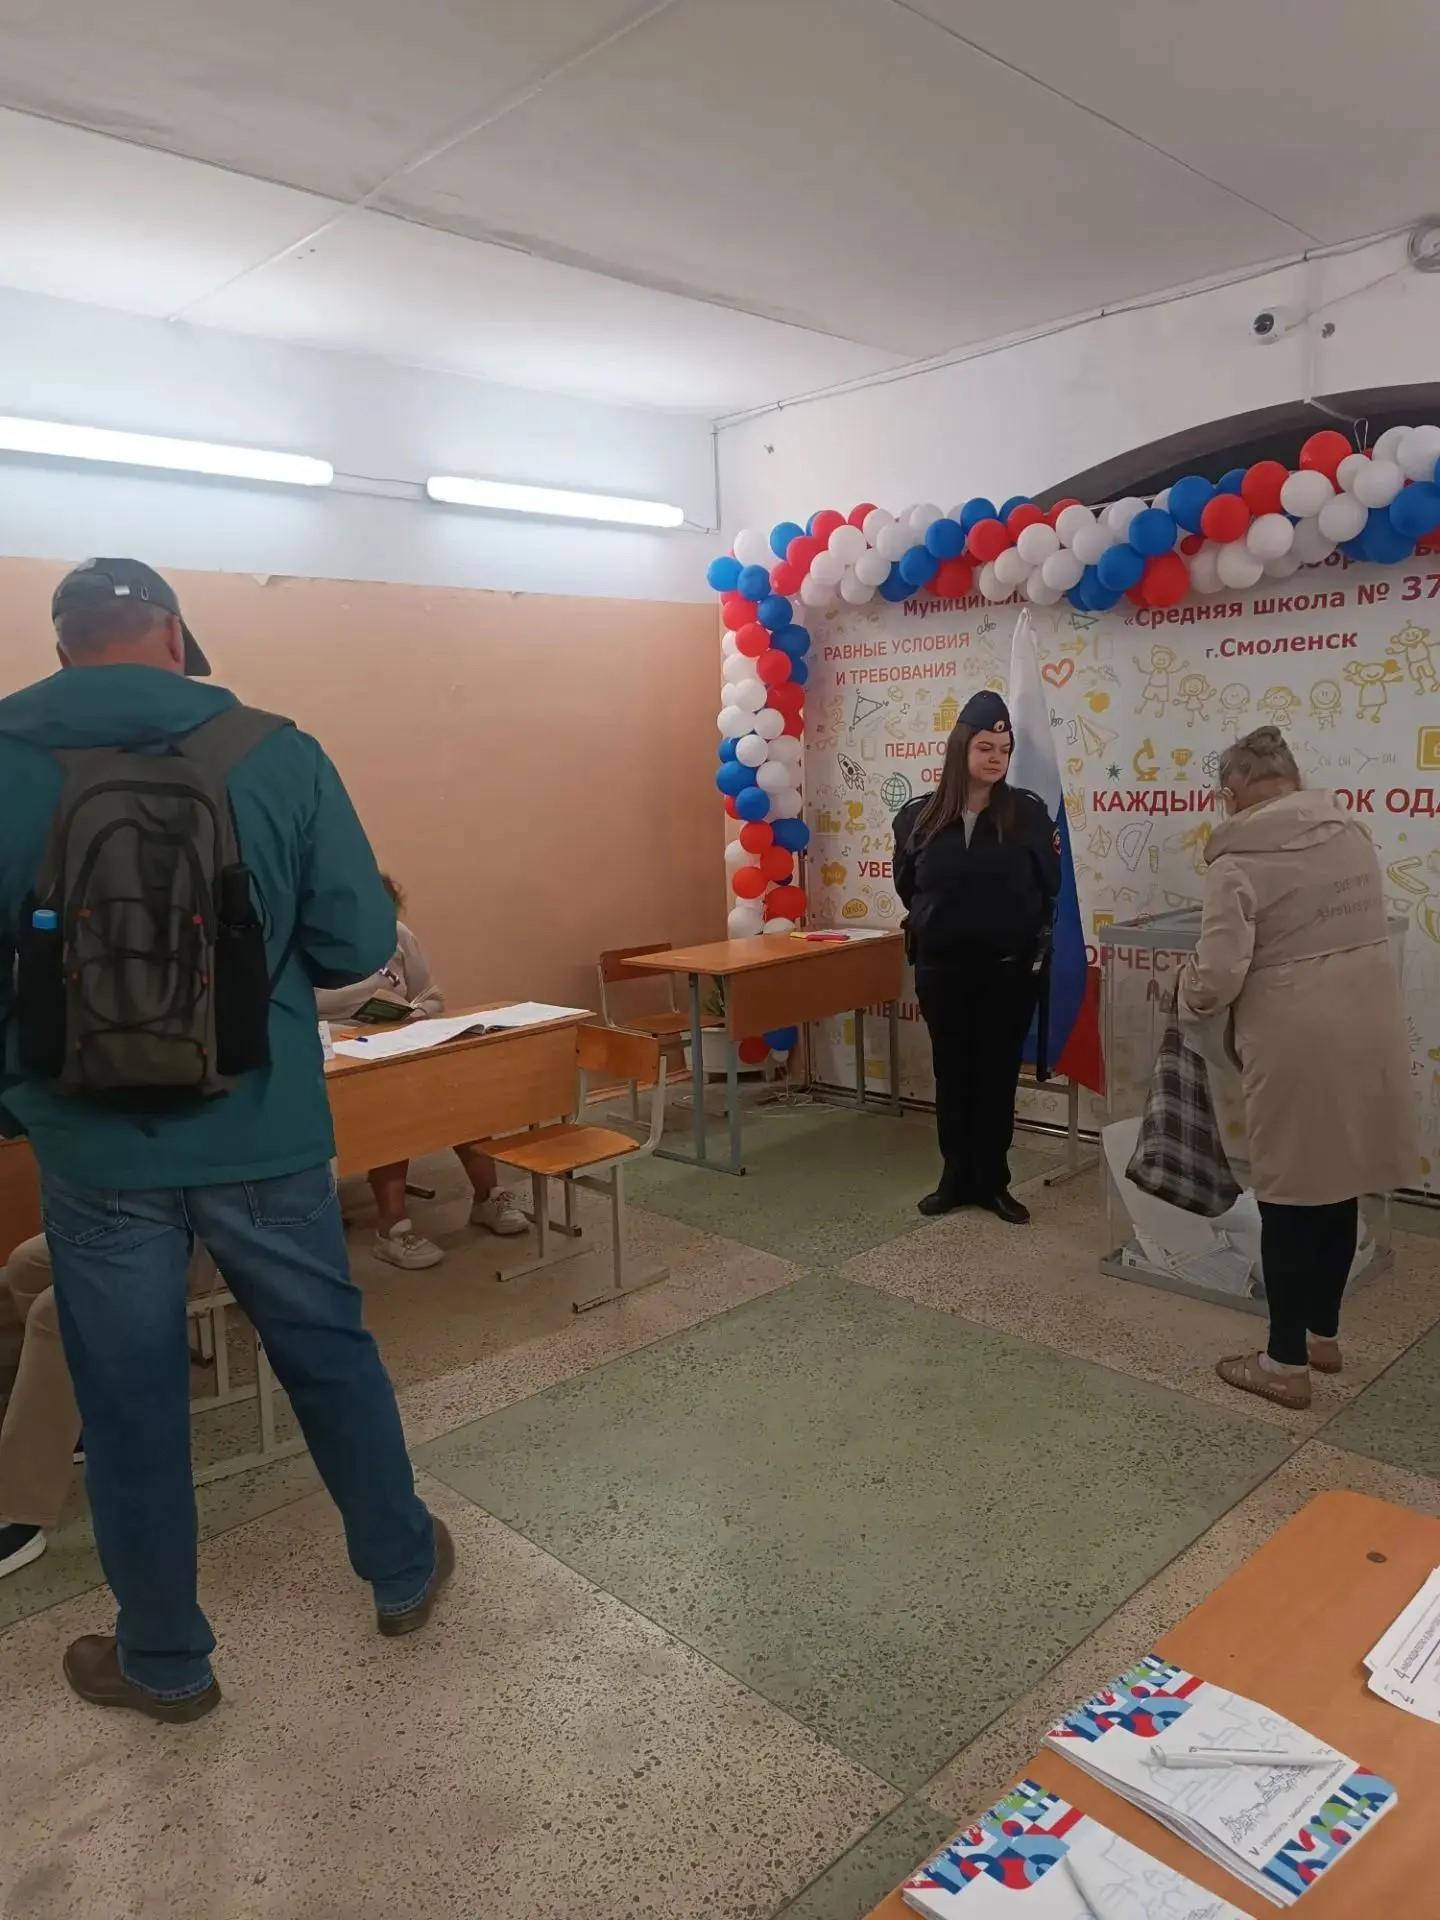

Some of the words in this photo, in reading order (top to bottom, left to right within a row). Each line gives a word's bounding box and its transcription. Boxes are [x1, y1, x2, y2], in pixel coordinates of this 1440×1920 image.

[1124, 601, 1243, 629] «Средняя
[1253, 591, 1345, 616] школа
[1357, 582, 1391, 605] №
[824, 642, 887, 661] РАВНЫЕ
[892, 632, 970, 655] УСЛОВИЯ
[836, 669, 846, 686] И
[850, 661, 957, 685] ТРЕБОВАНИЯ
[1093, 784, 1217, 816] КАЖДЫЙ
[858, 861, 892, 878] УВЕ
